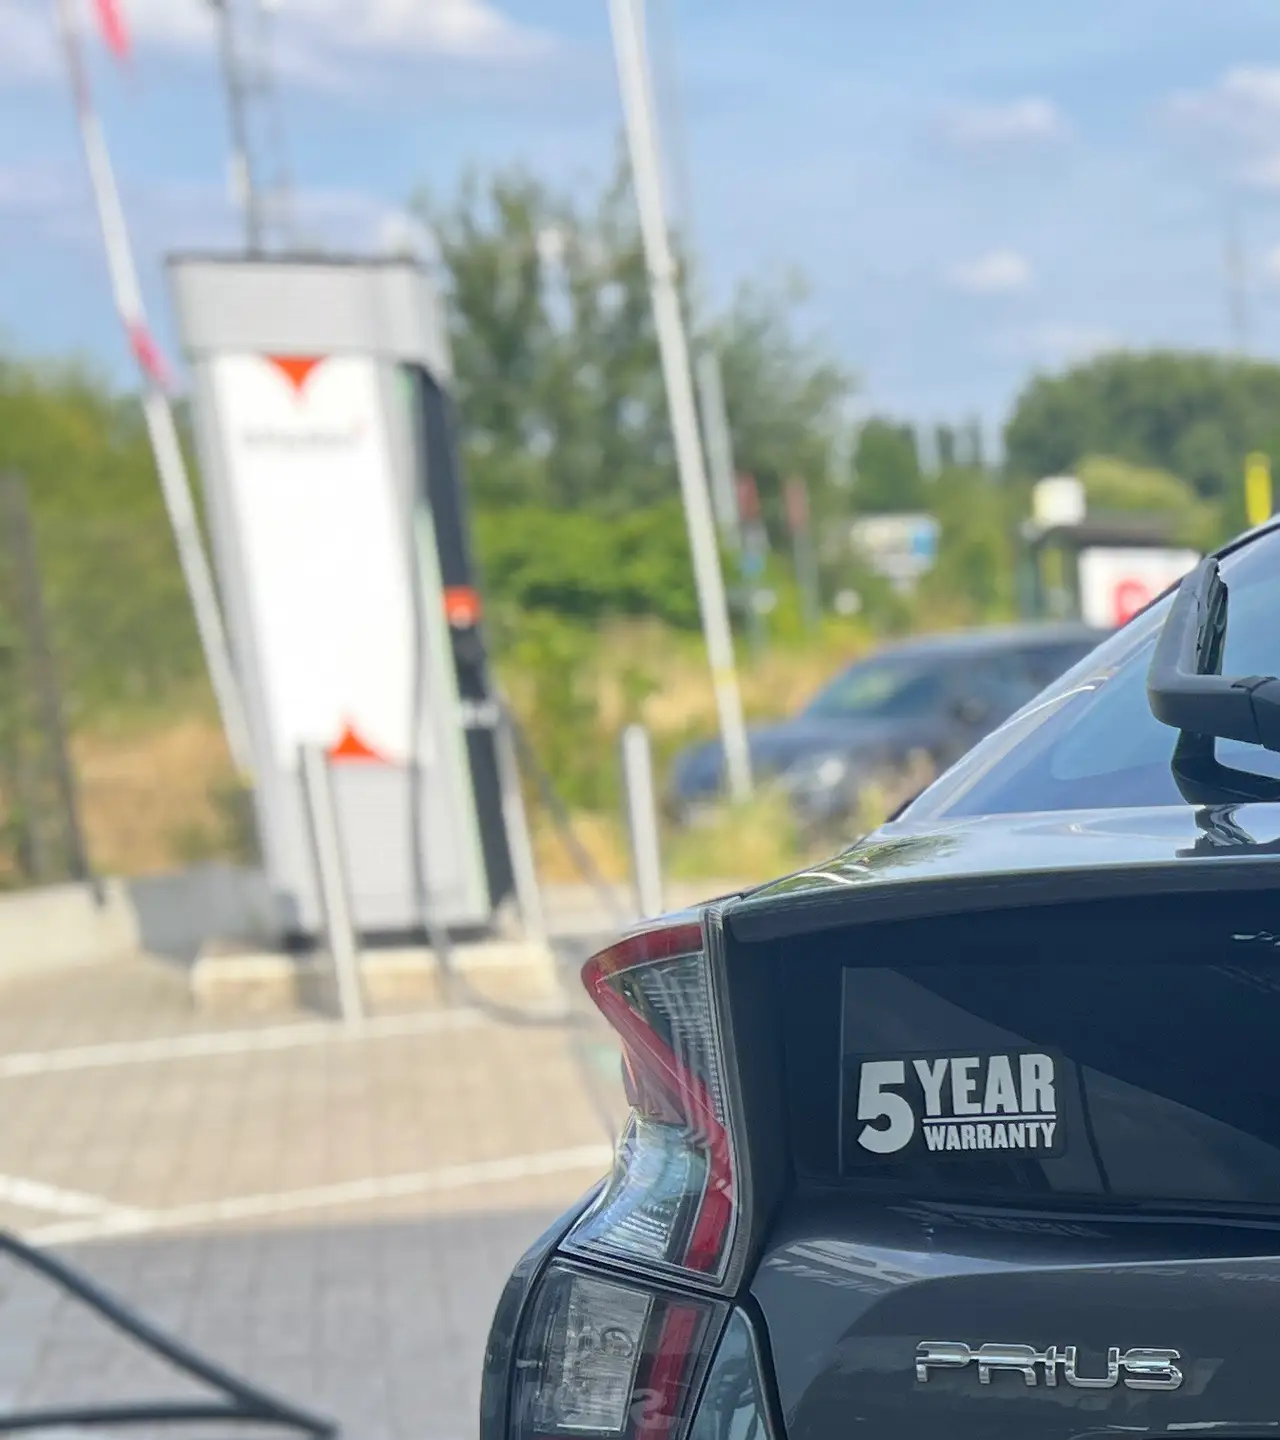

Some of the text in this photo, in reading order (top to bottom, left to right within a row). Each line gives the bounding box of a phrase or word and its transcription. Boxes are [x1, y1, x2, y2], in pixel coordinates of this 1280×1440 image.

[857, 1053, 1057, 1154] 5 YEAR
[922, 1122, 1057, 1152] WARRANTY
[914, 1340, 1185, 1391] PRIUS
